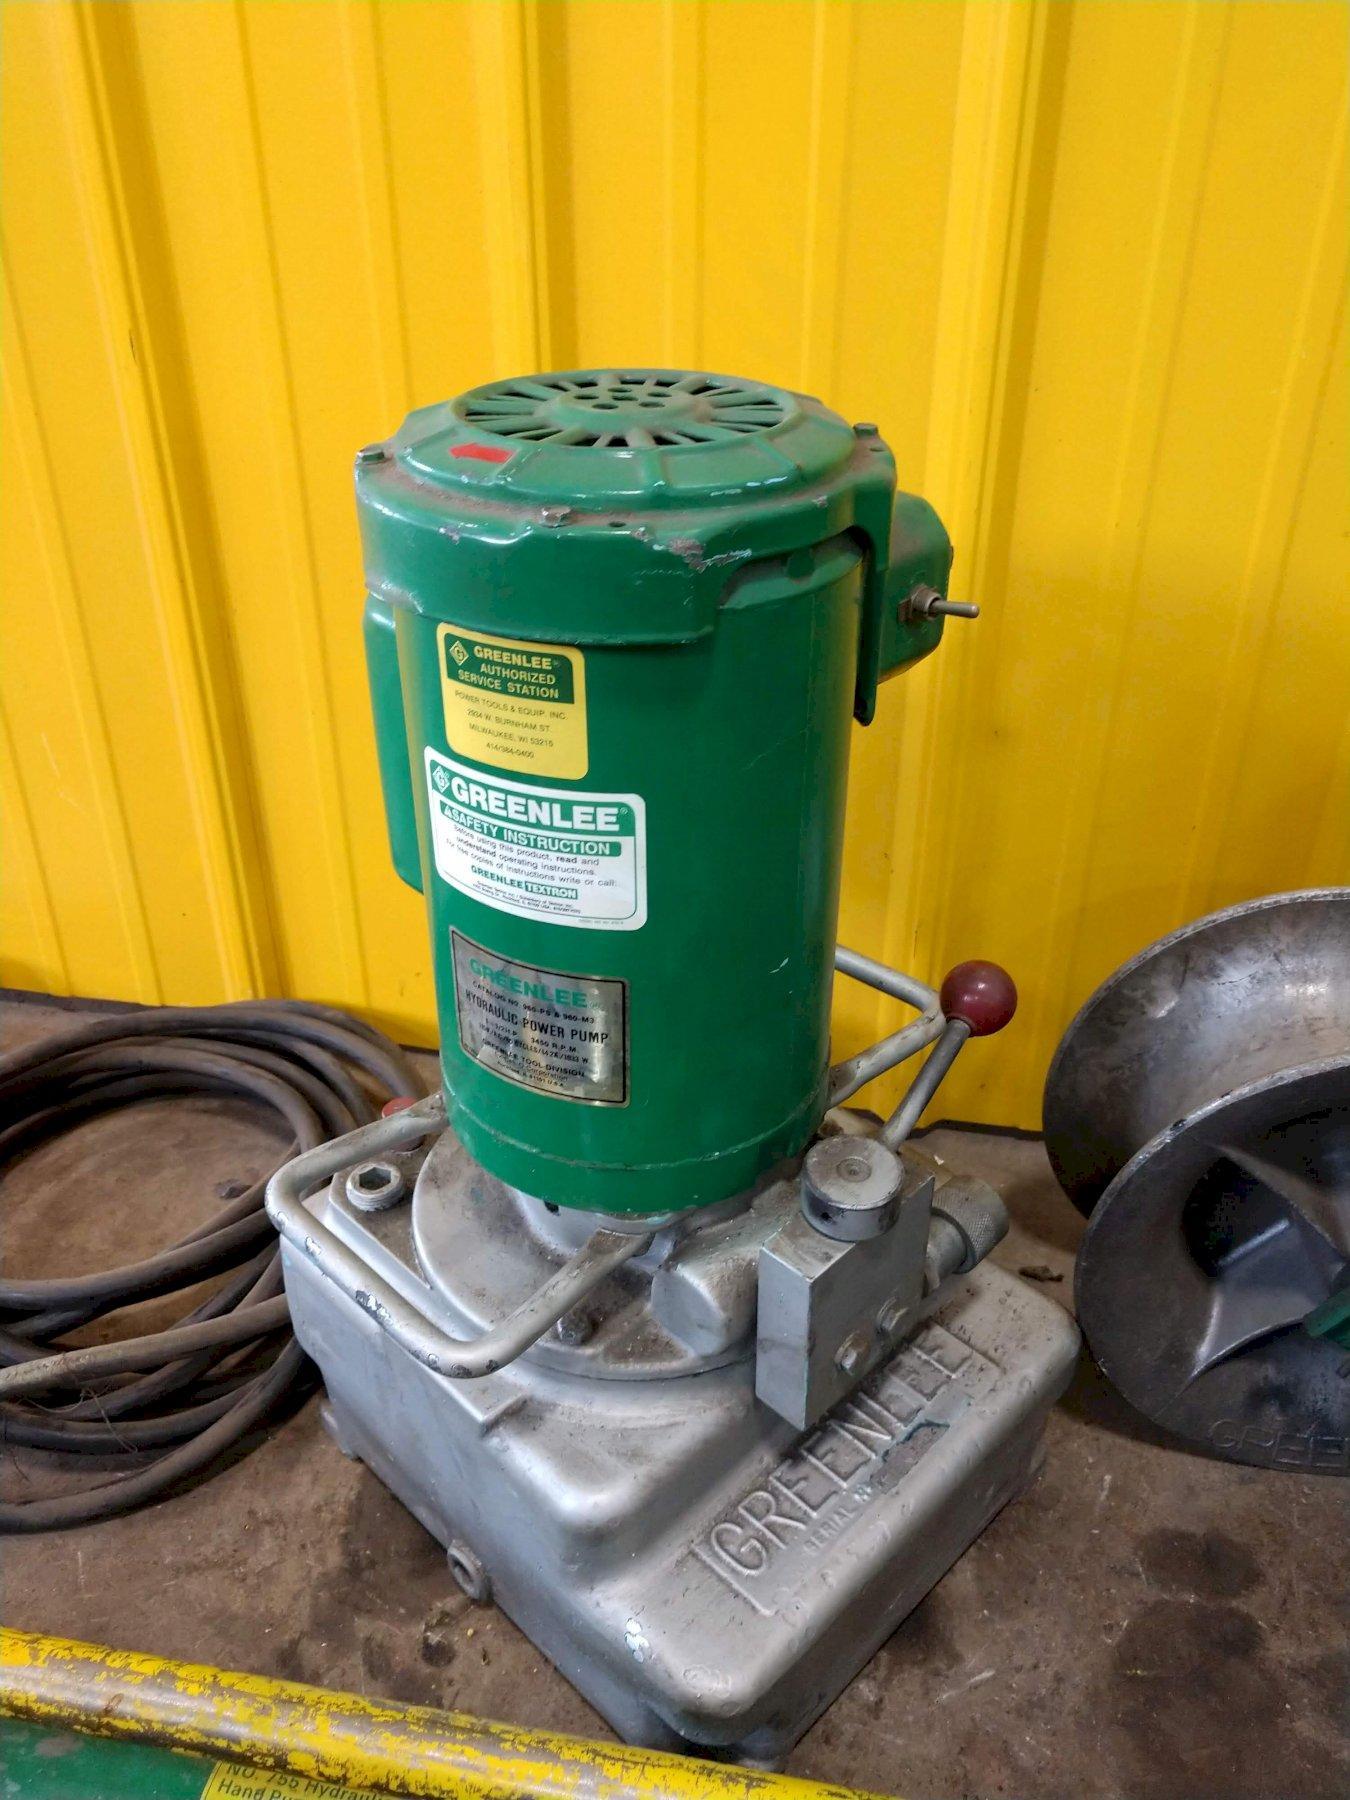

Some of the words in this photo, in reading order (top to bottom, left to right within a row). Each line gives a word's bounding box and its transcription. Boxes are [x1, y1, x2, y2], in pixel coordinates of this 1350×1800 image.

[473, 645, 552, 670] GREENLEE
[457, 669, 502, 690] SERVICE
[507, 682, 560, 699] STATION
[480, 663, 556, 685] AUTHORIZED
[455, 690, 479, 705] POWER
[482, 697, 509, 712] TOOLS
[510, 705, 516, 713] &
[518, 706, 546, 718] EQUIP.
[549, 711, 568, 721] INC.
[494, 716, 537, 730] BURNHAM
[451, 808, 499, 838] SAFETY
[503, 826, 610, 855] INSTRUCTION
[457, 836, 497, 857] understand
[499, 853, 538, 870] operating
[477, 836, 497, 850] using
[499, 841, 513, 853] this
[517, 847, 552, 862] product,
[556, 855, 577, 865] read
[581, 857, 600, 866] and
[471, 853, 494, 867] copies
[496, 862, 504, 870] of
[506, 864, 556, 881] instructions
[559, 875, 581, 885] write
[471, 865, 523, 889] GREENLEE
[526, 882, 577, 900] TEXTRON
[470, 958, 587, 1008] GREENLEE
[466, 989, 518, 1026] HYDRAULIC
[522, 1017, 565, 1039] POWER
[571, 1028, 609, 1044] PUMP
[522, 1057, 545, 1069] TOOL
[546, 1064, 585, 1077] DIVISION
[710, 1328, 976, 1578] GREENLEE
[1207, 1418, 1350, 1468] GREE
